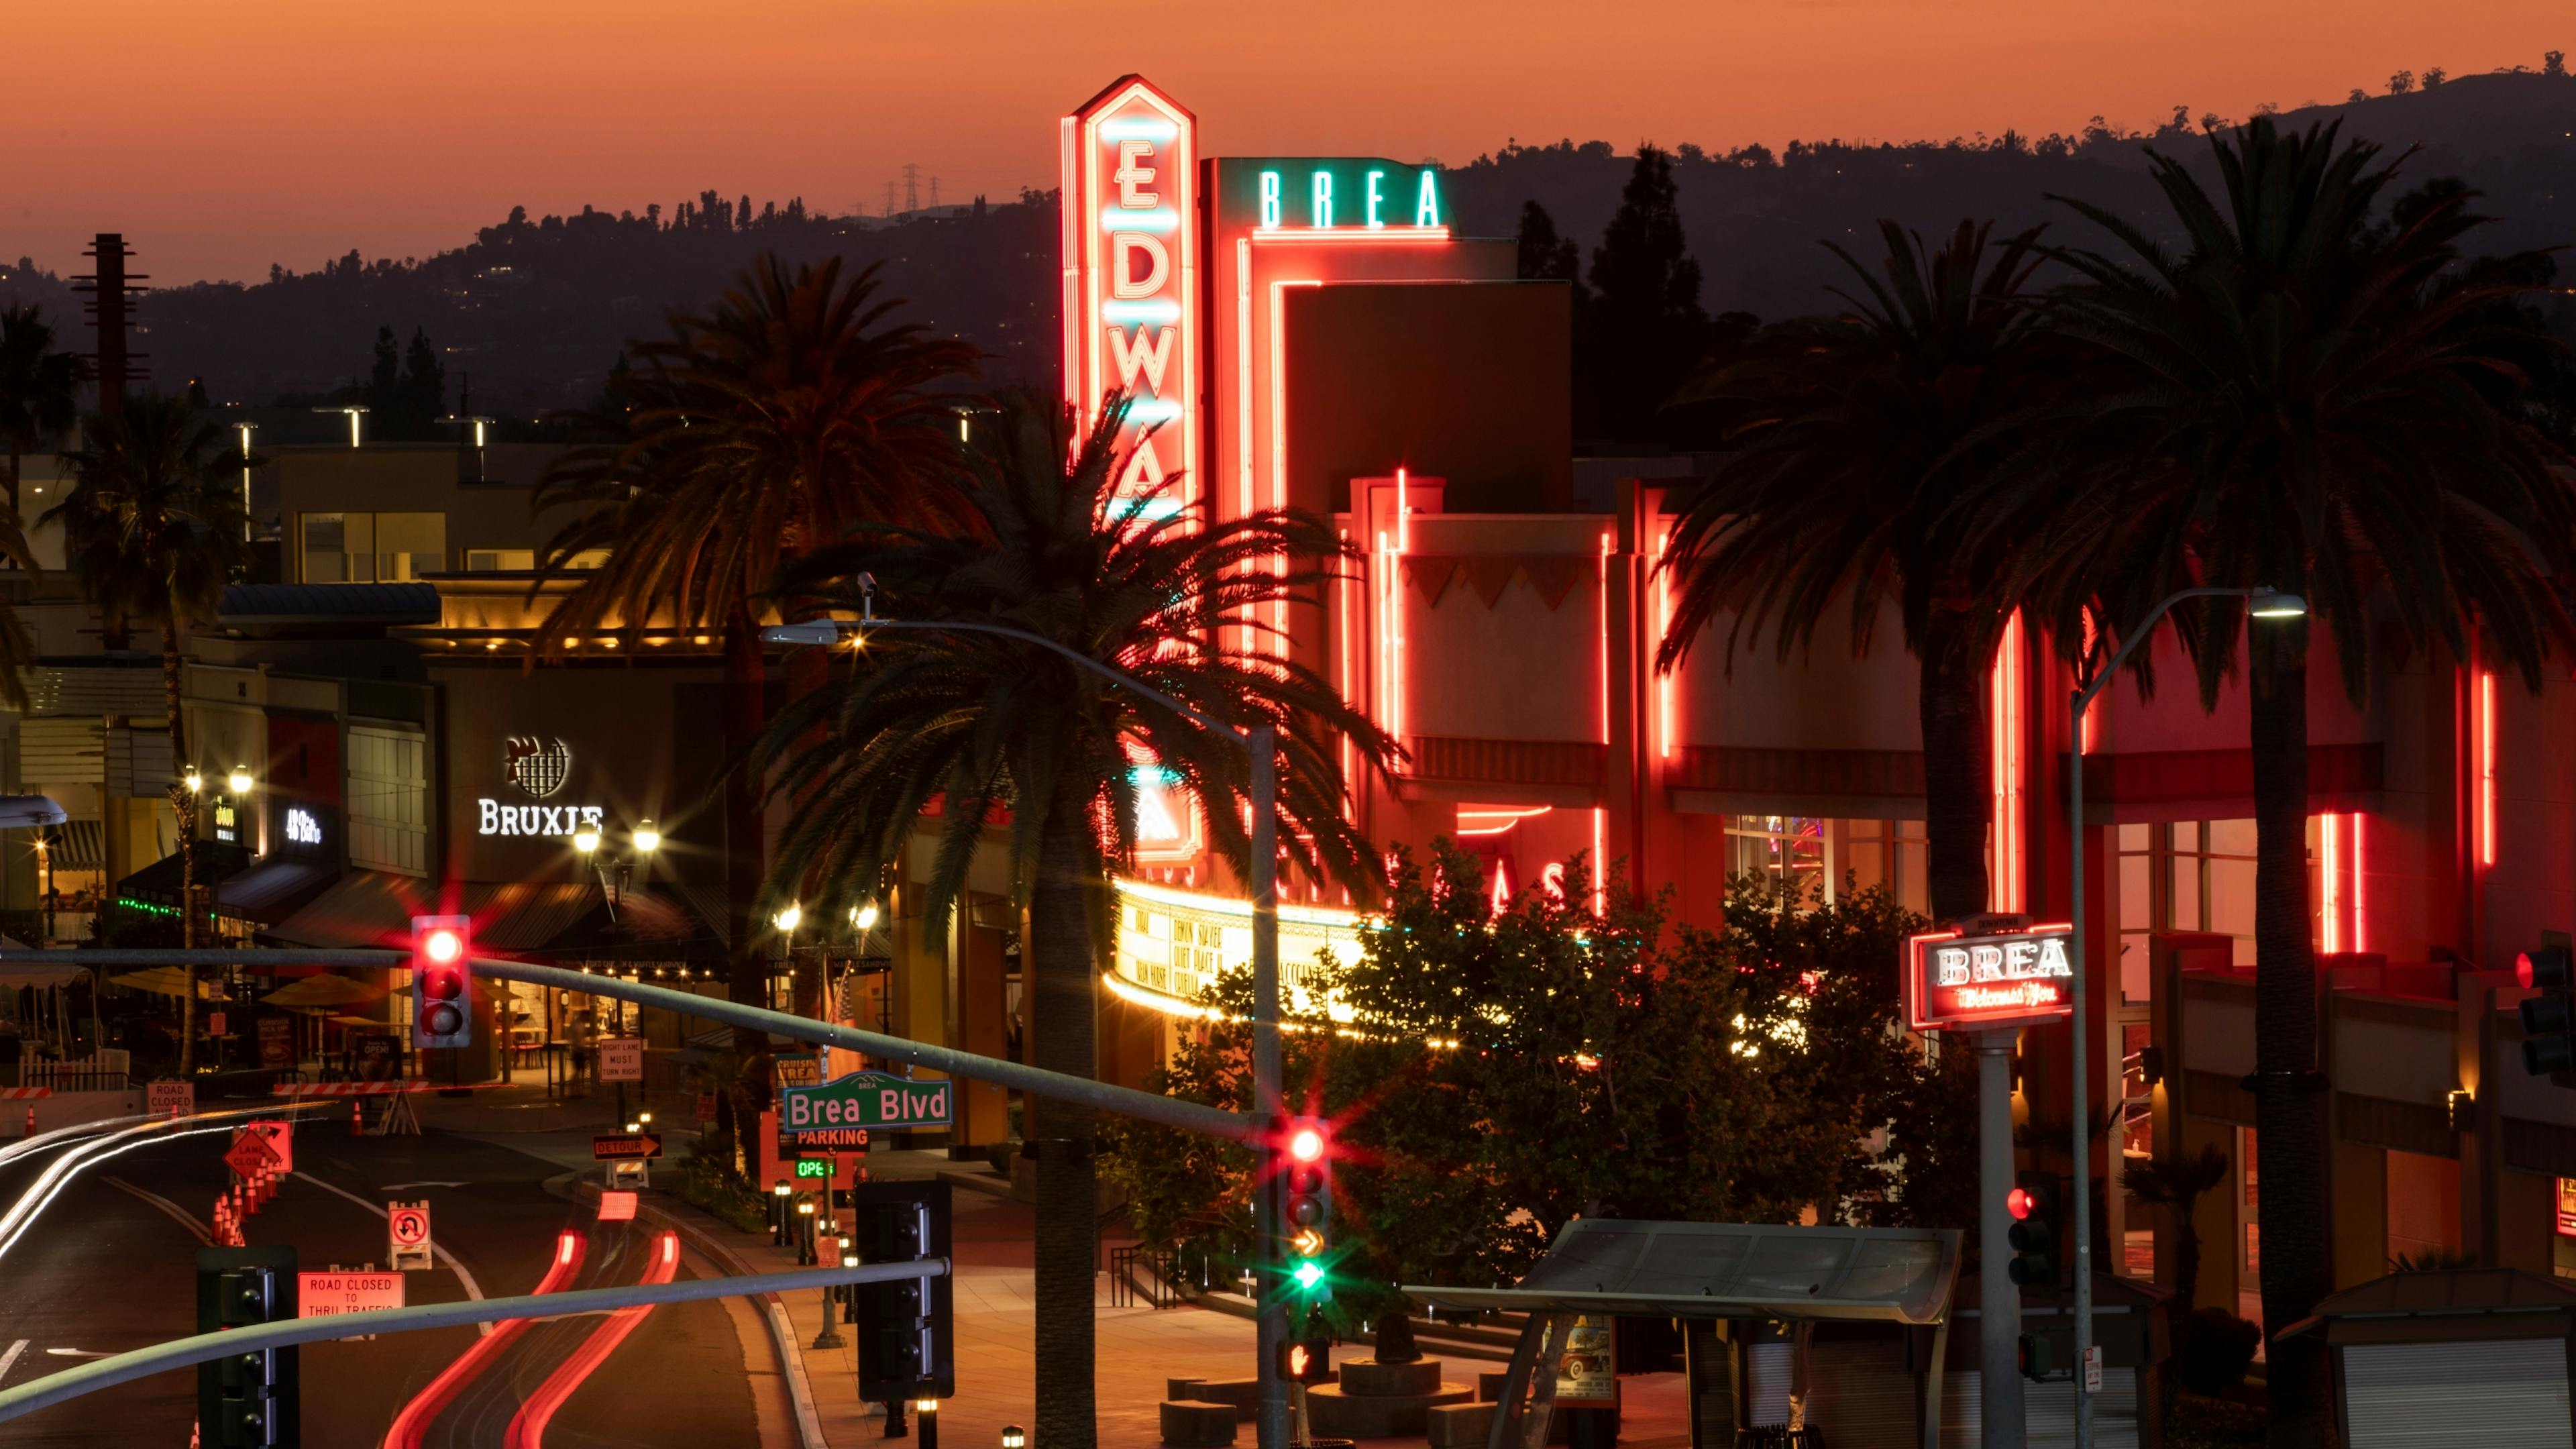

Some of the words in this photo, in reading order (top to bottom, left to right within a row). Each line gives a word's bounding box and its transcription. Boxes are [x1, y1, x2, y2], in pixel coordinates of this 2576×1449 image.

[1260, 170, 1442, 229] BREA
[478, 798, 604, 836] BRUXIE
[1174, 919, 1193, 943] DEMON
[1198, 924, 1222, 949] SLAYER
[1194, 949, 1214, 974] PLACE
[1937, 938, 2073, 987] BREA
[1955, 985, 2024, 1008] Welcomes
[2021, 981, 2057, 1007] You
[364, 1045, 390, 1054] OPEN!
[602, 1042, 621, 1052] RIGHT
[623, 1042, 639, 1052] LANE
[610, 1055, 633, 1064] MUST
[602, 1067, 620, 1076] TURN
[621, 1067, 640, 1076] RIGHT
[156, 1085, 184, 1095] ROAD
[151, 1097, 191, 1106] CLOSED
[791, 1093, 860, 1125] Brea
[881, 1087, 946, 1120] Blvd
[798, 1129, 868, 1145] PARKING
[239, 1145, 264, 1154] LANE
[598, 1141, 642, 1154] DETOUR
[311, 1279, 341, 1290] ROAD
[347, 1279, 392, 1291] CLOSED
[345, 1293, 357, 1302] TO
[309, 1305, 339, 1317] THRU
